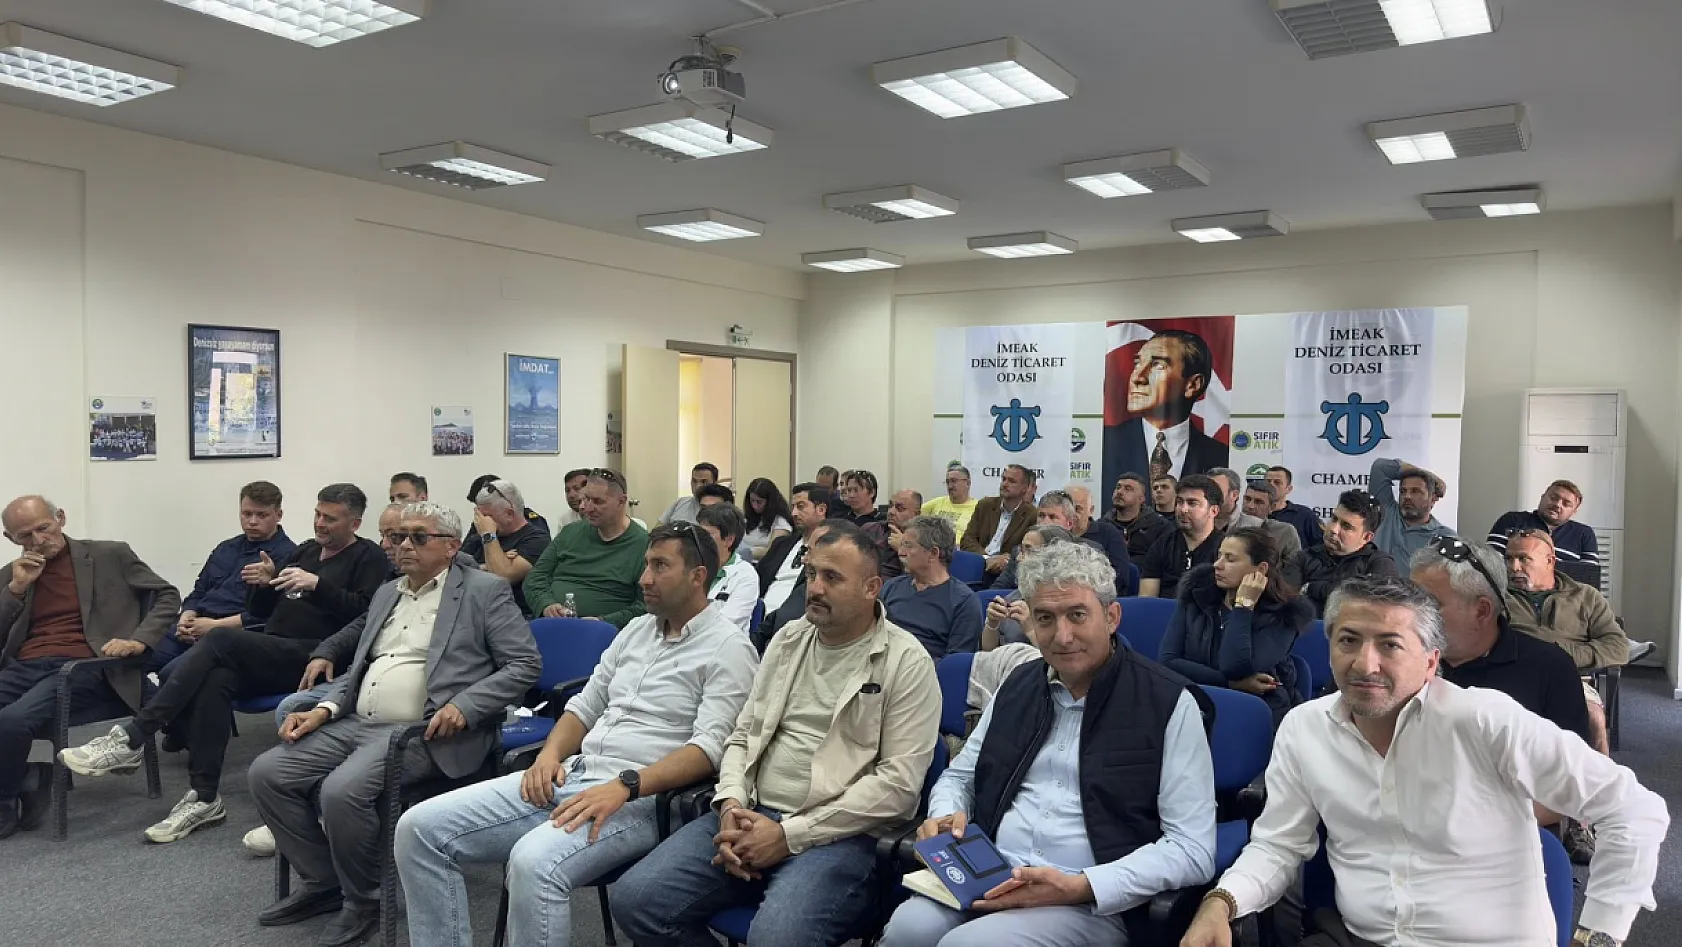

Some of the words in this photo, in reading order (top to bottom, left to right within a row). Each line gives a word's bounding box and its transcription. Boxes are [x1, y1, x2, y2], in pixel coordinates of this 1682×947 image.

[1330, 327, 1385, 340] İMEAK
[997, 341, 1038, 353] İMEAK
[1294, 345, 1345, 358] DENİZ
[1349, 343, 1421, 357] TİCARET
[971, 356, 1009, 368] DENİZ
[1012, 356, 1066, 368] TİCARET
[1329, 363, 1382, 374] ODASI
[997, 372, 1037, 382] ODASI
[1253, 431, 1280, 440] SIFIR
[1253, 441, 1279, 450] ATIK
[1070, 462, 1091, 470] SIFIR
[1070, 470, 1091, 479] ATIK
